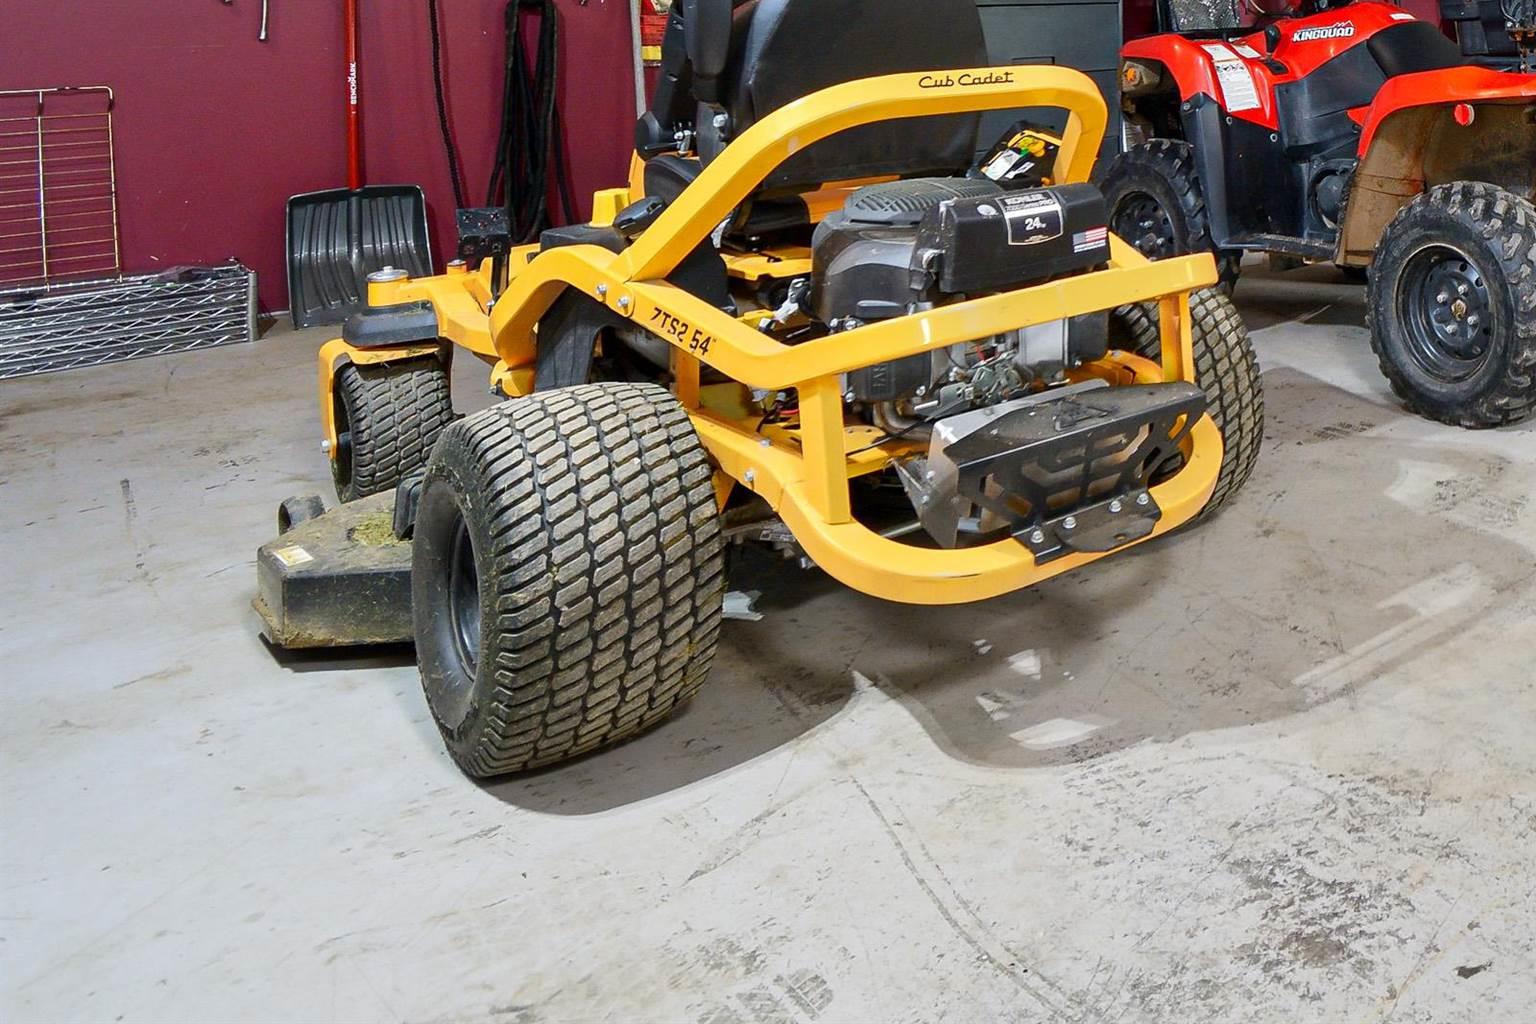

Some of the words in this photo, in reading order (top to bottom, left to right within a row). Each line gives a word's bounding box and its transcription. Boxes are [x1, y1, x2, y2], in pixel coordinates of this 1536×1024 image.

[1293, 26, 1355, 42] KINGQUAD
[919, 75, 955, 89] Cub
[958, 71, 1014, 86] Cadet
[1025, 216, 1041, 231] 24
